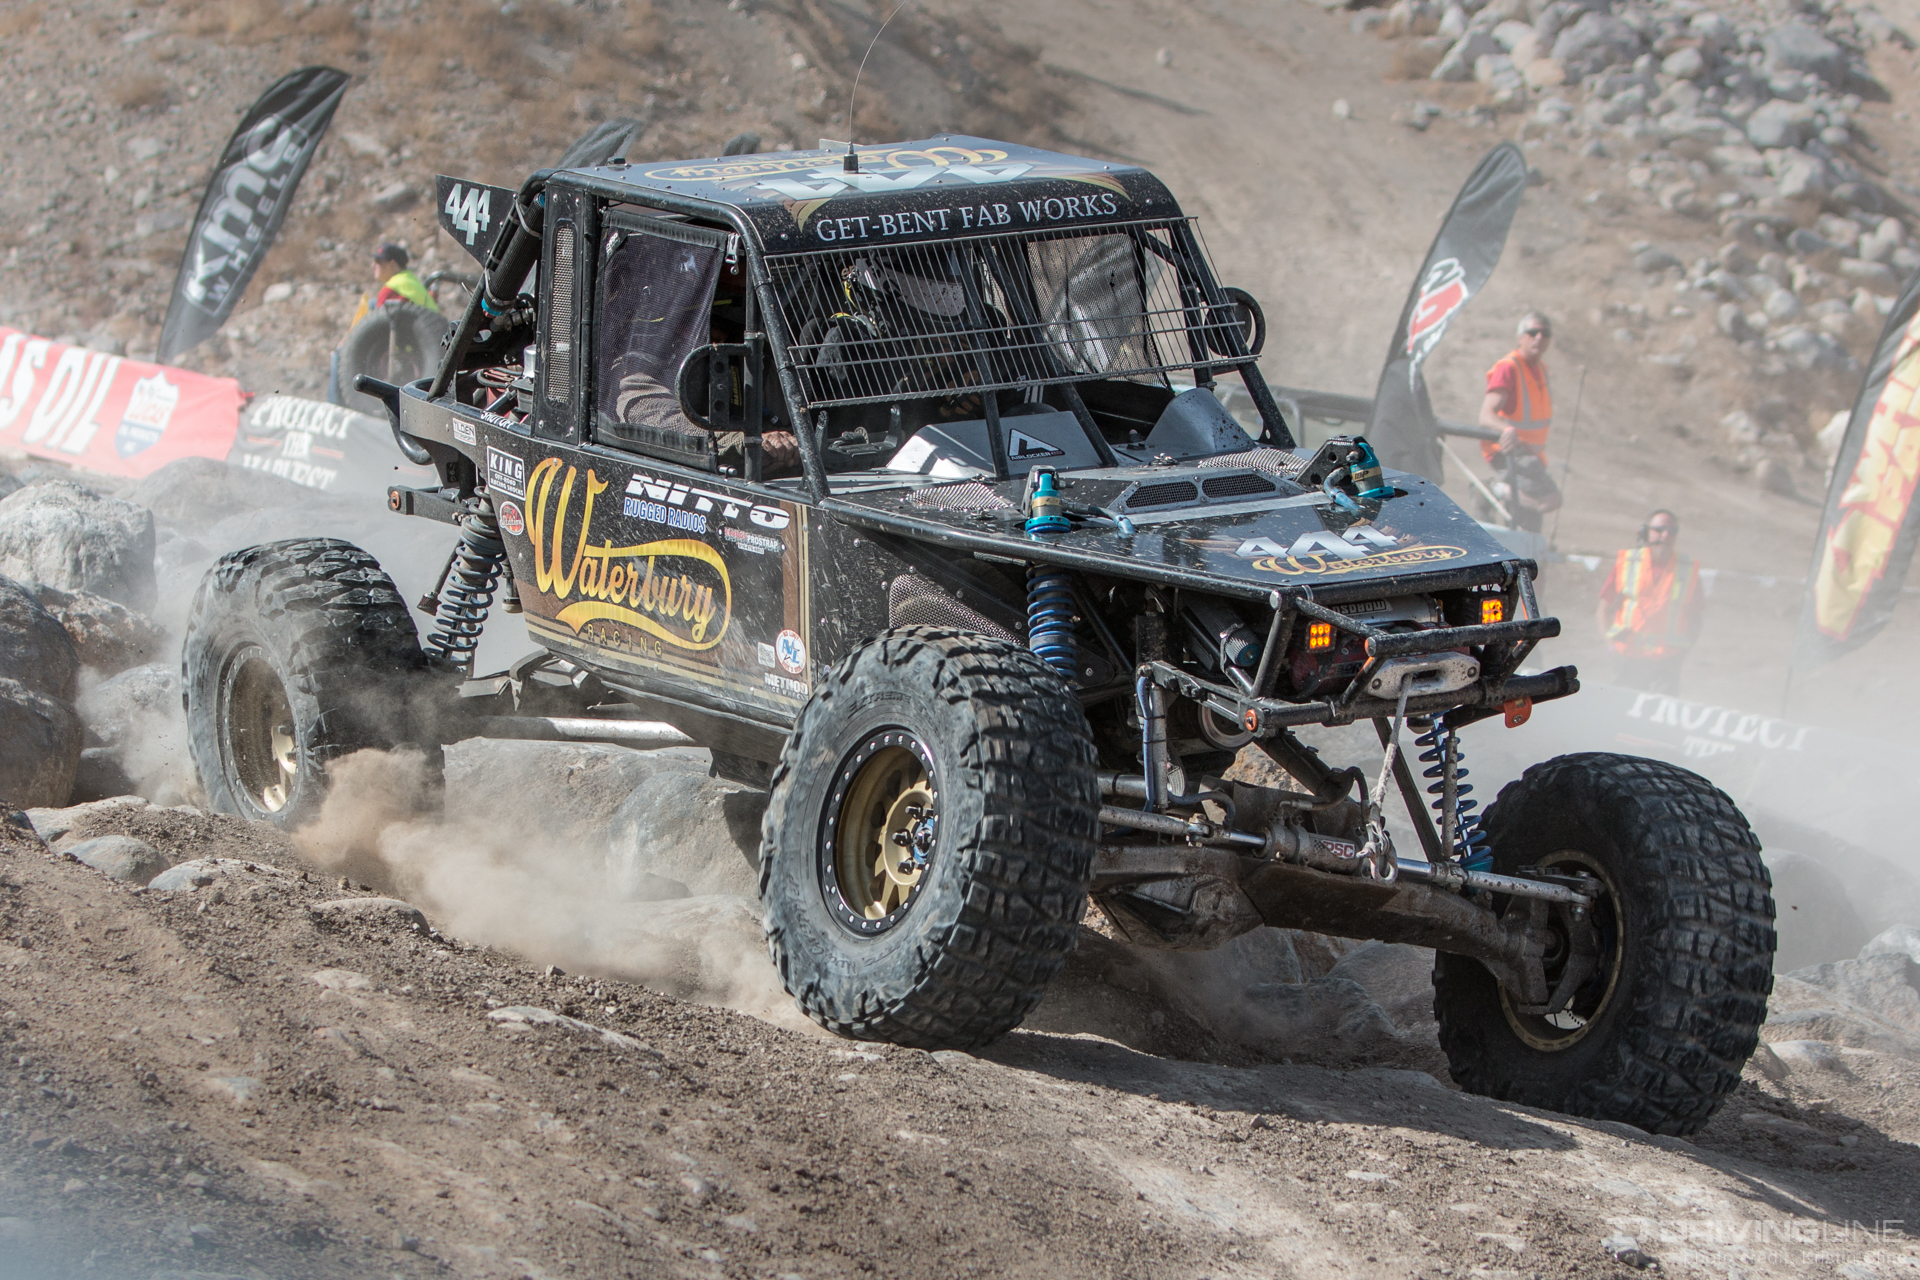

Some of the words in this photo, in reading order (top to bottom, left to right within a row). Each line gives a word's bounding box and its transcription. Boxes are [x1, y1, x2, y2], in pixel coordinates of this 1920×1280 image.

[444, 183, 491, 246] 444
[816, 208, 951, 242] GET-BENT
[959, 203, 1012, 229] FAB
[1017, 193, 1118, 223] WORKS
[22, 345, 122, 455] OIL
[251, 395, 359, 439] PROTECT
[490, 452, 523, 480] KING
[623, 496, 667, 523] RUGGED
[667, 510, 707, 535] RADIOS
[525, 456, 716, 643] Waterbury
[747, 534, 779, 549] PROSTRAP
[1235, 525, 1398, 562] 444
[1252, 548, 1452, 576] Waterbury
[587, 623, 663, 655] RACING
[764, 672, 809, 695] METHOD
[1627, 692, 1814, 752] PROTECT
